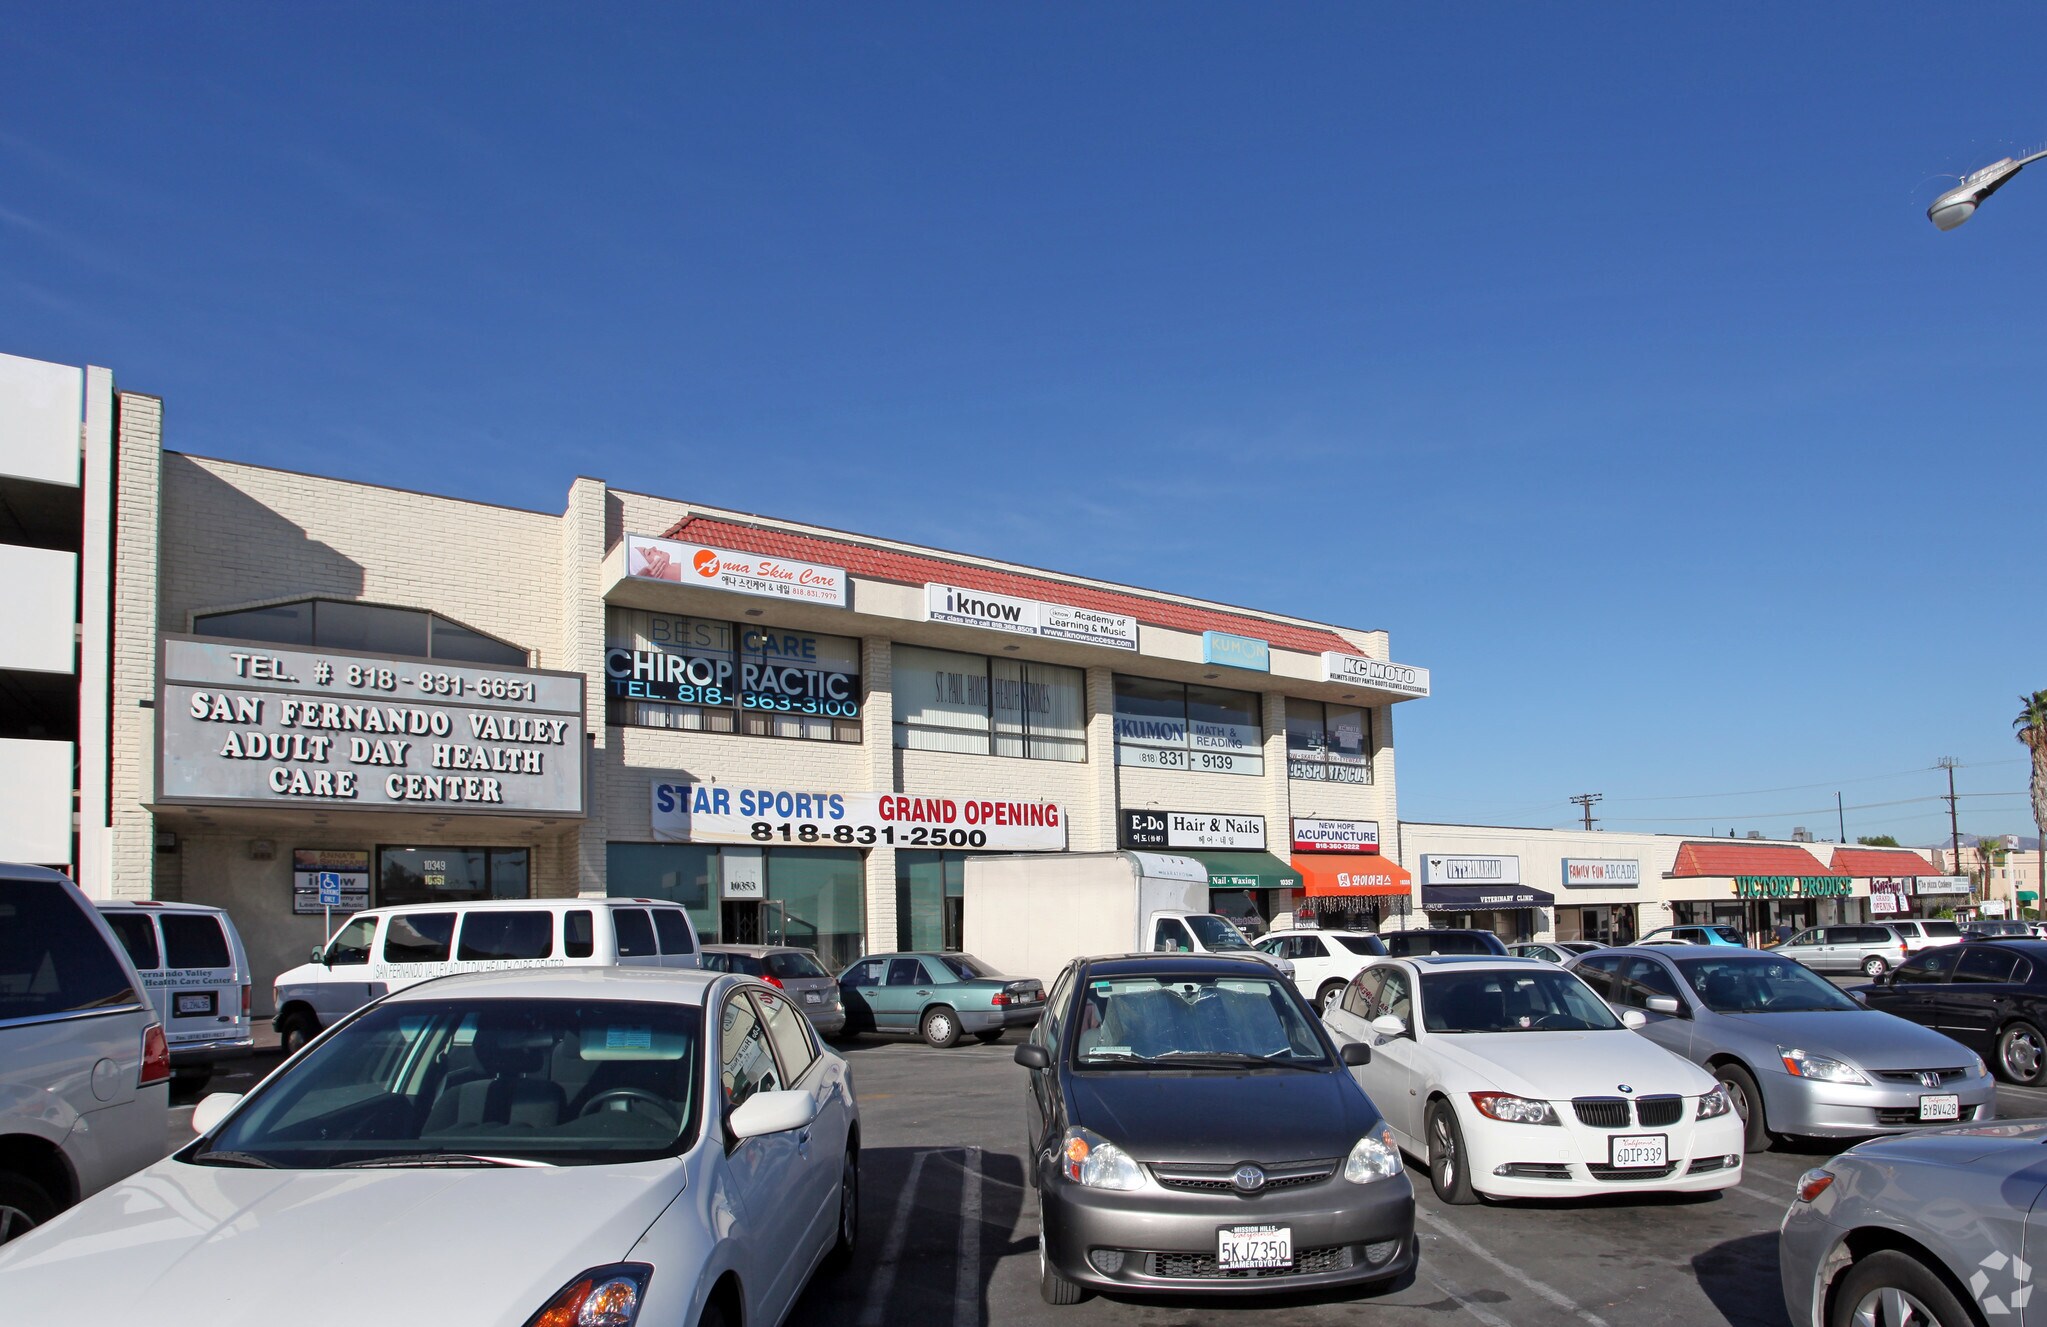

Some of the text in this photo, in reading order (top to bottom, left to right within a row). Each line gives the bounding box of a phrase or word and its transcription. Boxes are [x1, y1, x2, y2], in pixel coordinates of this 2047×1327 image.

[696, 556, 835, 587] Anna Skin Care
[721, 576, 838, 600] 애나 스킨케어 & 네일 818.831.7979
[947, 614, 964, 623] class
[965, 617, 978, 625] info
[1049, 617, 1127, 637] Learning & Music
[1074, 611, 1115, 626] Academy
[652, 618, 817, 659] BEST CARE
[1043, 628, 1132, 648] www.iknowsuccess.com
[1212, 638, 1265, 659] KUMON
[230, 653, 298, 682] TEL.
[314, 660, 333, 685] #
[1344, 658, 1415, 684] KC MOTO
[610, 679, 667, 700] TEL.
[935, 671, 947, 703] ST.
[948, 672, 965, 705] PAUL
[968, 675, 988, 707] HOME
[995, 678, 1020, 710] HEALTH
[1330, 673, 1347, 682] HELMETS
[1362, 677, 1375, 686] PANTS
[1388, 682, 1402, 690] GLOVES
[1402, 685, 1428, 694] ACCESSORIES
[190, 691, 568, 745] SAN FERNANDO VALLEY
[1121, 718, 1184, 742] KUMON
[1196, 724, 1237, 738] MATH &
[1197, 736, 1243, 749] READING
[219, 730, 544, 775] ADULT DAY HEALTH
[1139, 752, 1158, 763] (818)
[1159, 751, 1184, 766] 831
[1202, 754, 1233, 770] 9139
[269, 766, 503, 804] CARE CENTER
[657, 784, 1059, 827] STAR SPORTS GRAND OPENING
[1132, 815, 1260, 834] E-Do Hair & Nails
[1318, 822, 1336, 830] NEW
[750, 822, 987, 847] 818-831-2500
[1297, 829, 1376, 842] ACUPUNCTURE
[424, 861, 445, 871] 10349
[1447, 859, 1501, 879] VETERINARIAN
[1569, 864, 1637, 880] FAMILY FUN ARCADE
[730, 881, 757, 891] 10353
[1212, 876, 1256, 886] Nail Waxing
[1735, 876, 1796, 897] VICTORY
[1799, 876, 1853, 896] PRODUCE
[1480, 894, 1534, 903] VETERINARY CLINIC
[185, 969, 213, 978] Valley
[375, 963, 388, 979] SAN
[388, 963, 423, 978] FERNANDO
[424, 962, 449, 977] VALLEY
[145, 978, 177, 987] Health
[1923, 1103, 1956, 1116] 5YBV428
[1623, 1139, 1653, 1147] California
[1617, 1147, 1662, 1163] 6DIP339
[1222, 1241, 1287, 1261] 5KJZ350
[1218, 1259, 1292, 1269] www.HAMERTOYOTA.com
